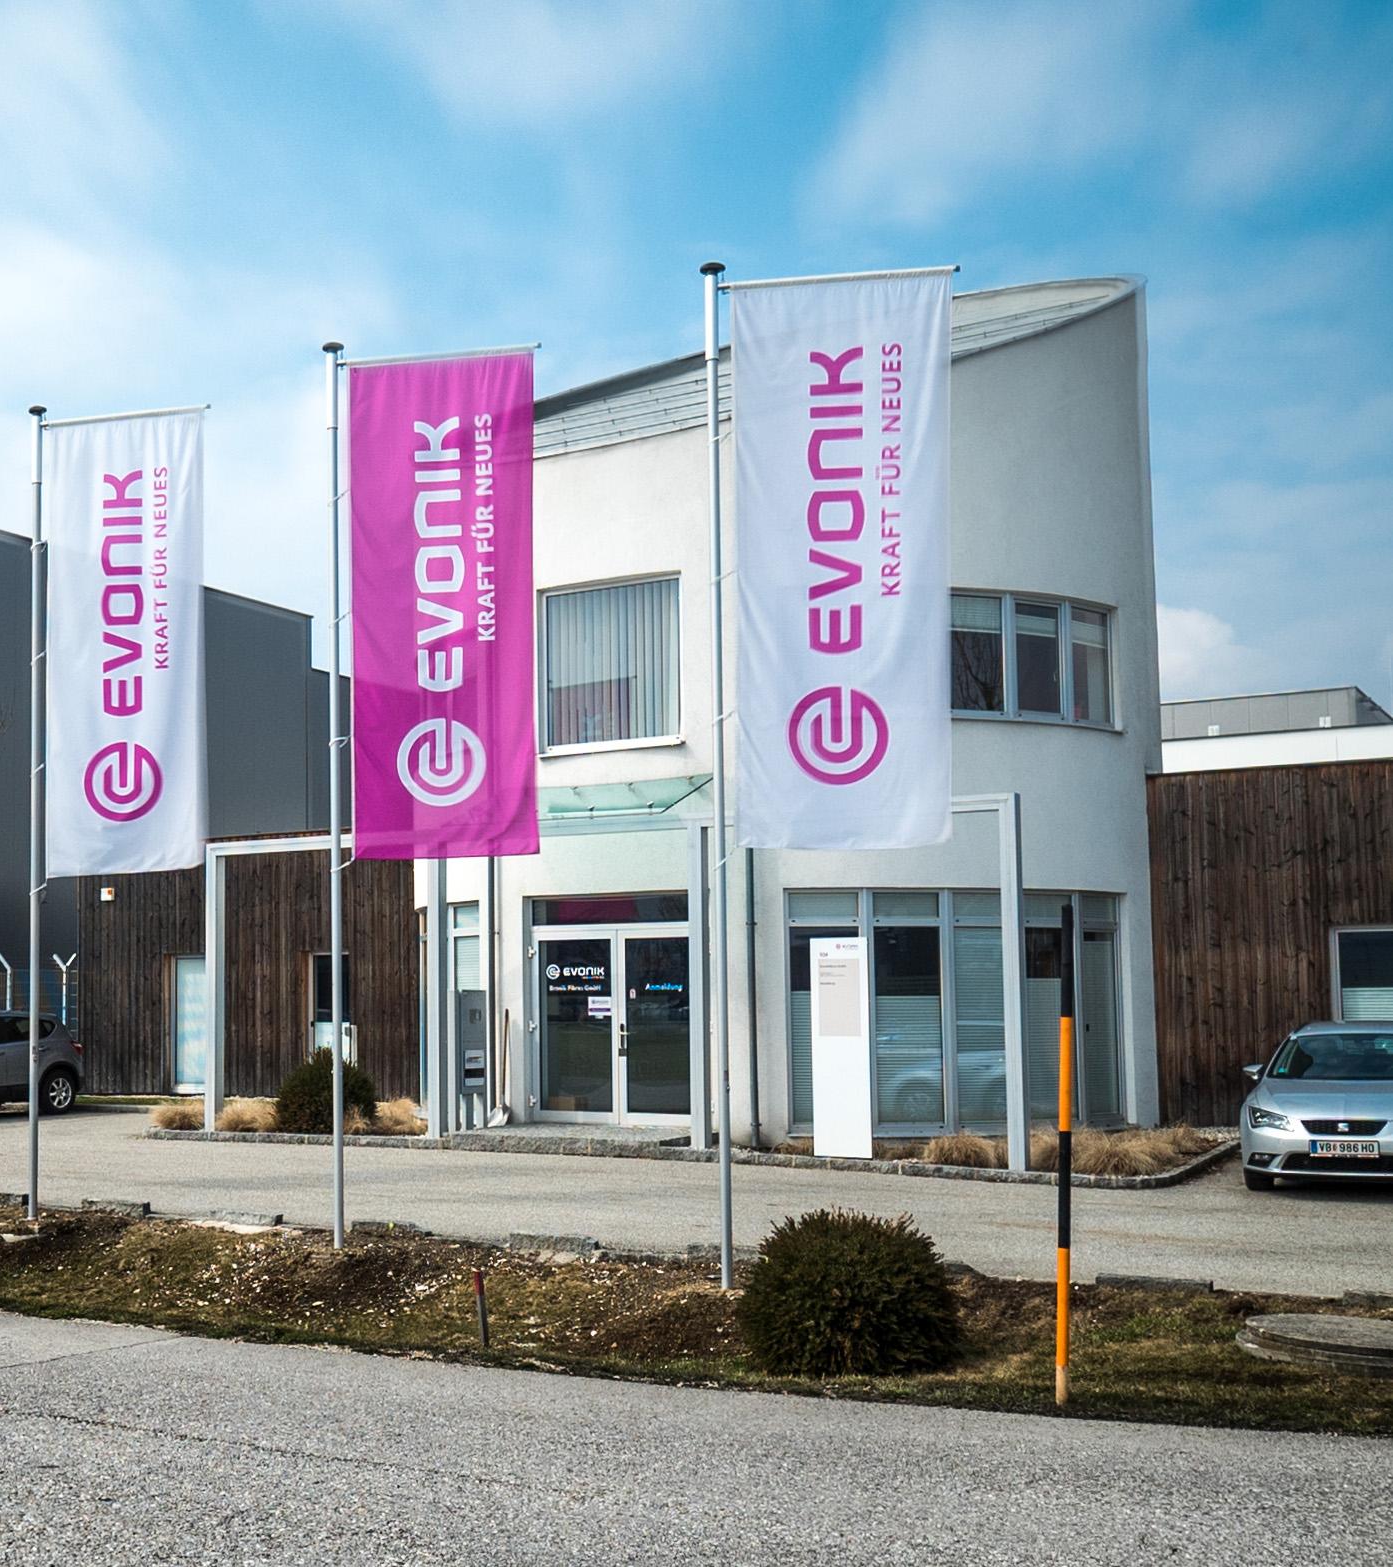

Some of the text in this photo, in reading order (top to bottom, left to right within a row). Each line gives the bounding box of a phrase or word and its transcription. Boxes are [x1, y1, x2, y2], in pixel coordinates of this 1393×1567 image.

[149, 466, 169, 670] KRAFT FÜR NEUES
[414, 416, 465, 692] EVONIK
[471, 413, 496, 642] KRAFT FÜR NEUES
[807, 346, 864, 654] EVONIK
[874, 343, 903, 597] KRAFT FÜR NEUES
[101, 470, 143, 717] EVONIK
[563, 967, 605, 977] EVONIK
[1319, 1143, 1332, 1153] VB
[1339, 1143, 1359, 1153] 986
